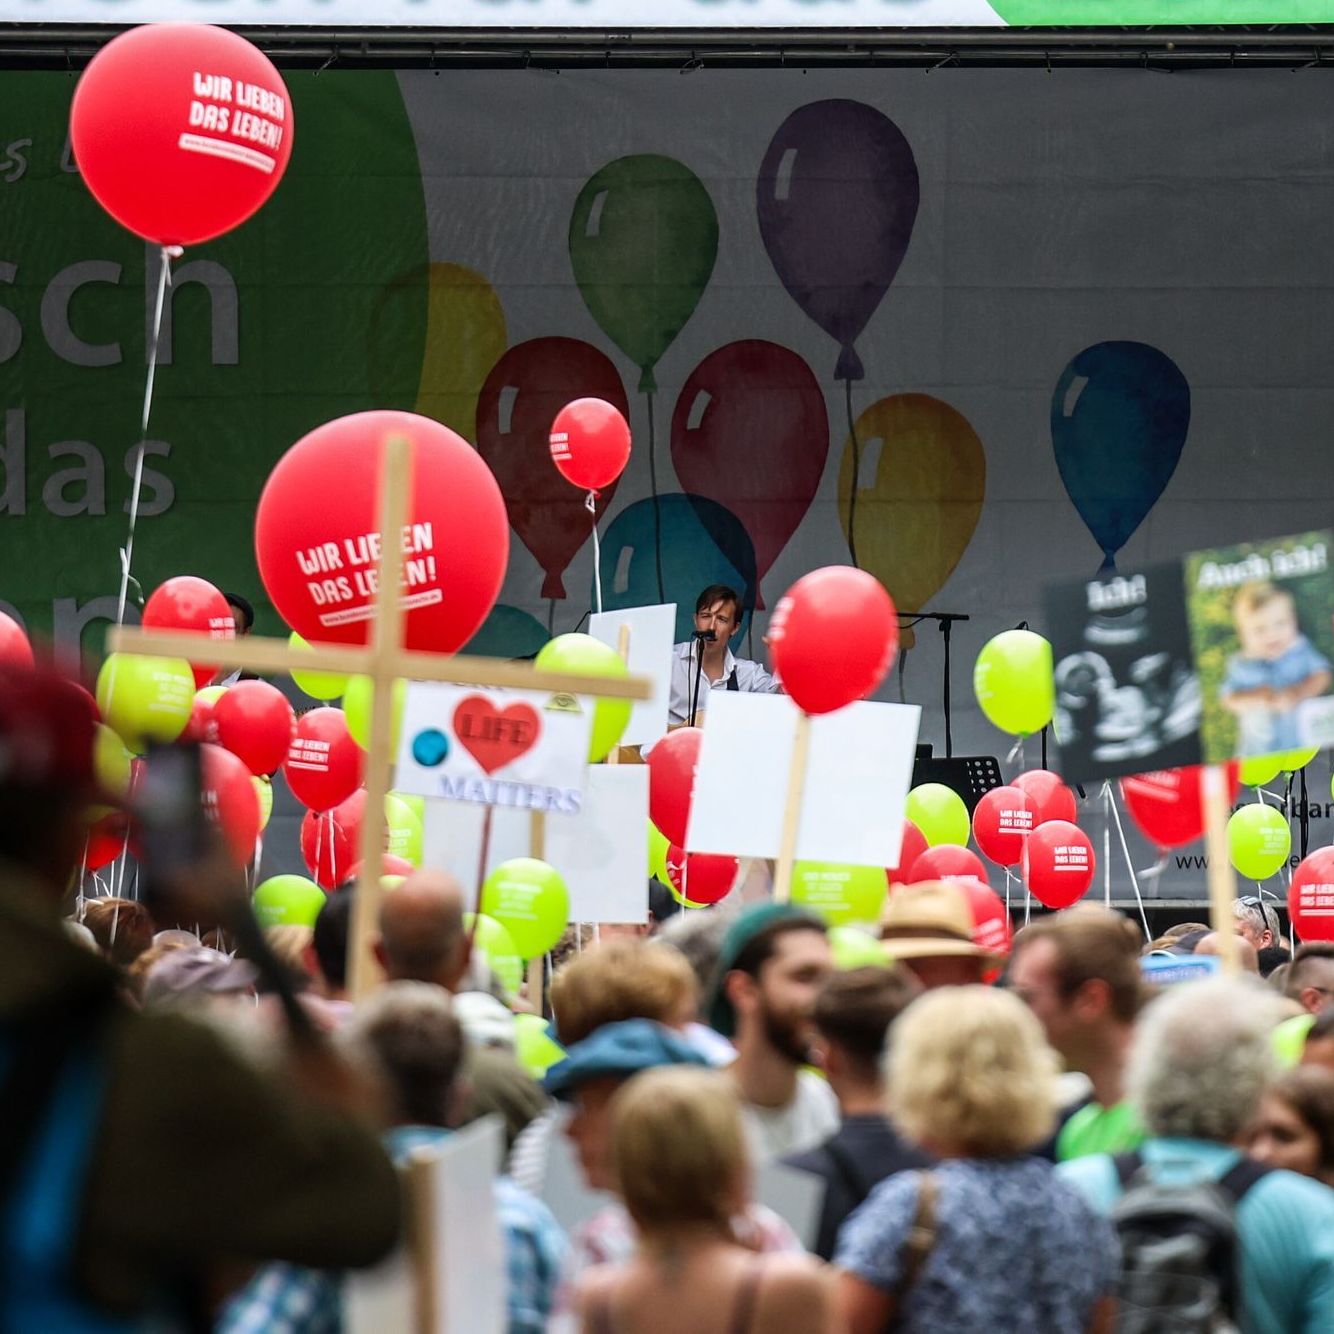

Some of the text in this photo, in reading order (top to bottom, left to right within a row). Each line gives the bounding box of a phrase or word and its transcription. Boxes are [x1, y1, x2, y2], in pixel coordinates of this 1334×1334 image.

[193, 71, 285, 121] WIR LIEBEN
[189, 100, 283, 151] DAS LEBEN!
[296, 521, 434, 576] WIR LIEEN
[1197, 542, 1327, 588] Auch ich!
[307, 576, 354, 606] DAS
[461, 714, 532, 744] LIFE
[439, 775, 582, 813] MATTERS
[1000, 819, 1012, 827] DAS
[1054, 855, 1068, 864] DAS
